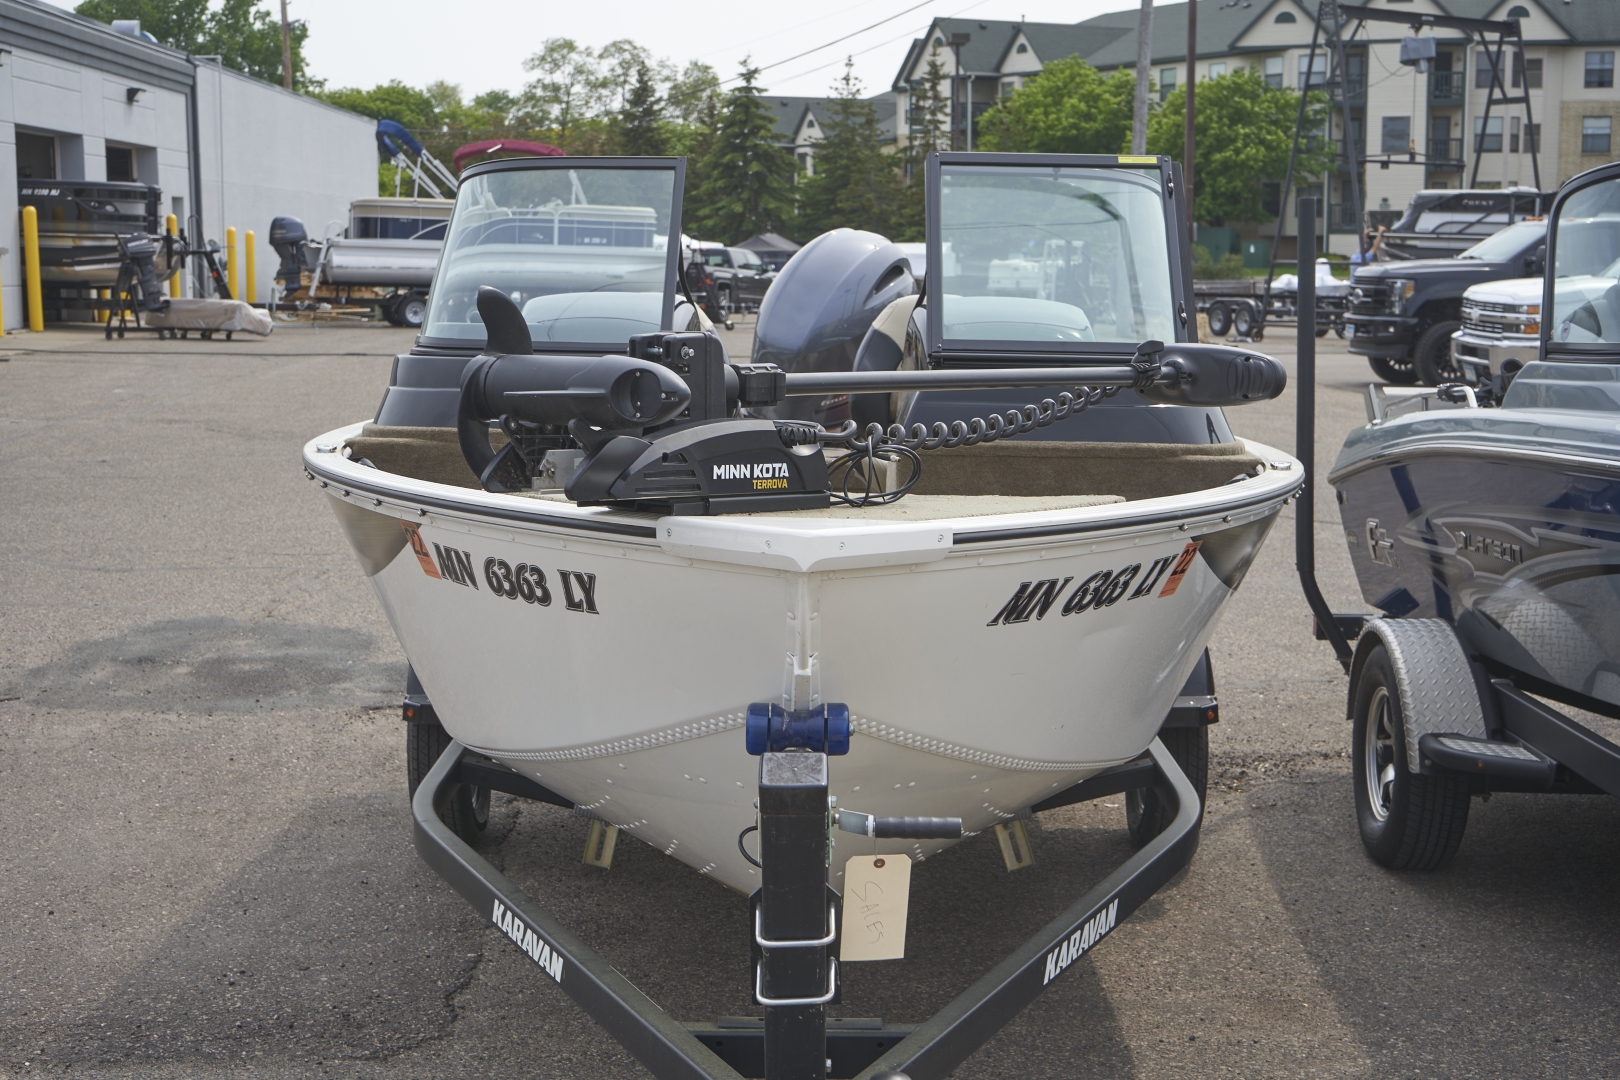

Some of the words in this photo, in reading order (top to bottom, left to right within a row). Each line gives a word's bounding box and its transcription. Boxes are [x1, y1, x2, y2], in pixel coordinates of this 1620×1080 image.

[713, 464, 751, 480] MINN
[753, 462, 789, 478] KOTA
[752, 478, 788, 490] TERROVA
[404, 527, 430, 557] 22
[1170, 546, 1198, 576] 22
[432, 541, 479, 590] MN
[484, 556, 552, 607] 6363
[557, 568, 600, 614] LY
[986, 576, 1074, 627] MN
[1061, 562, 1142, 616] 6363
[1127, 553, 1179, 601] LY
[492, 898, 564, 984] KARAVAN
[851, 881, 884, 944] SALES
[1043, 898, 1119, 986] KARAVAN
